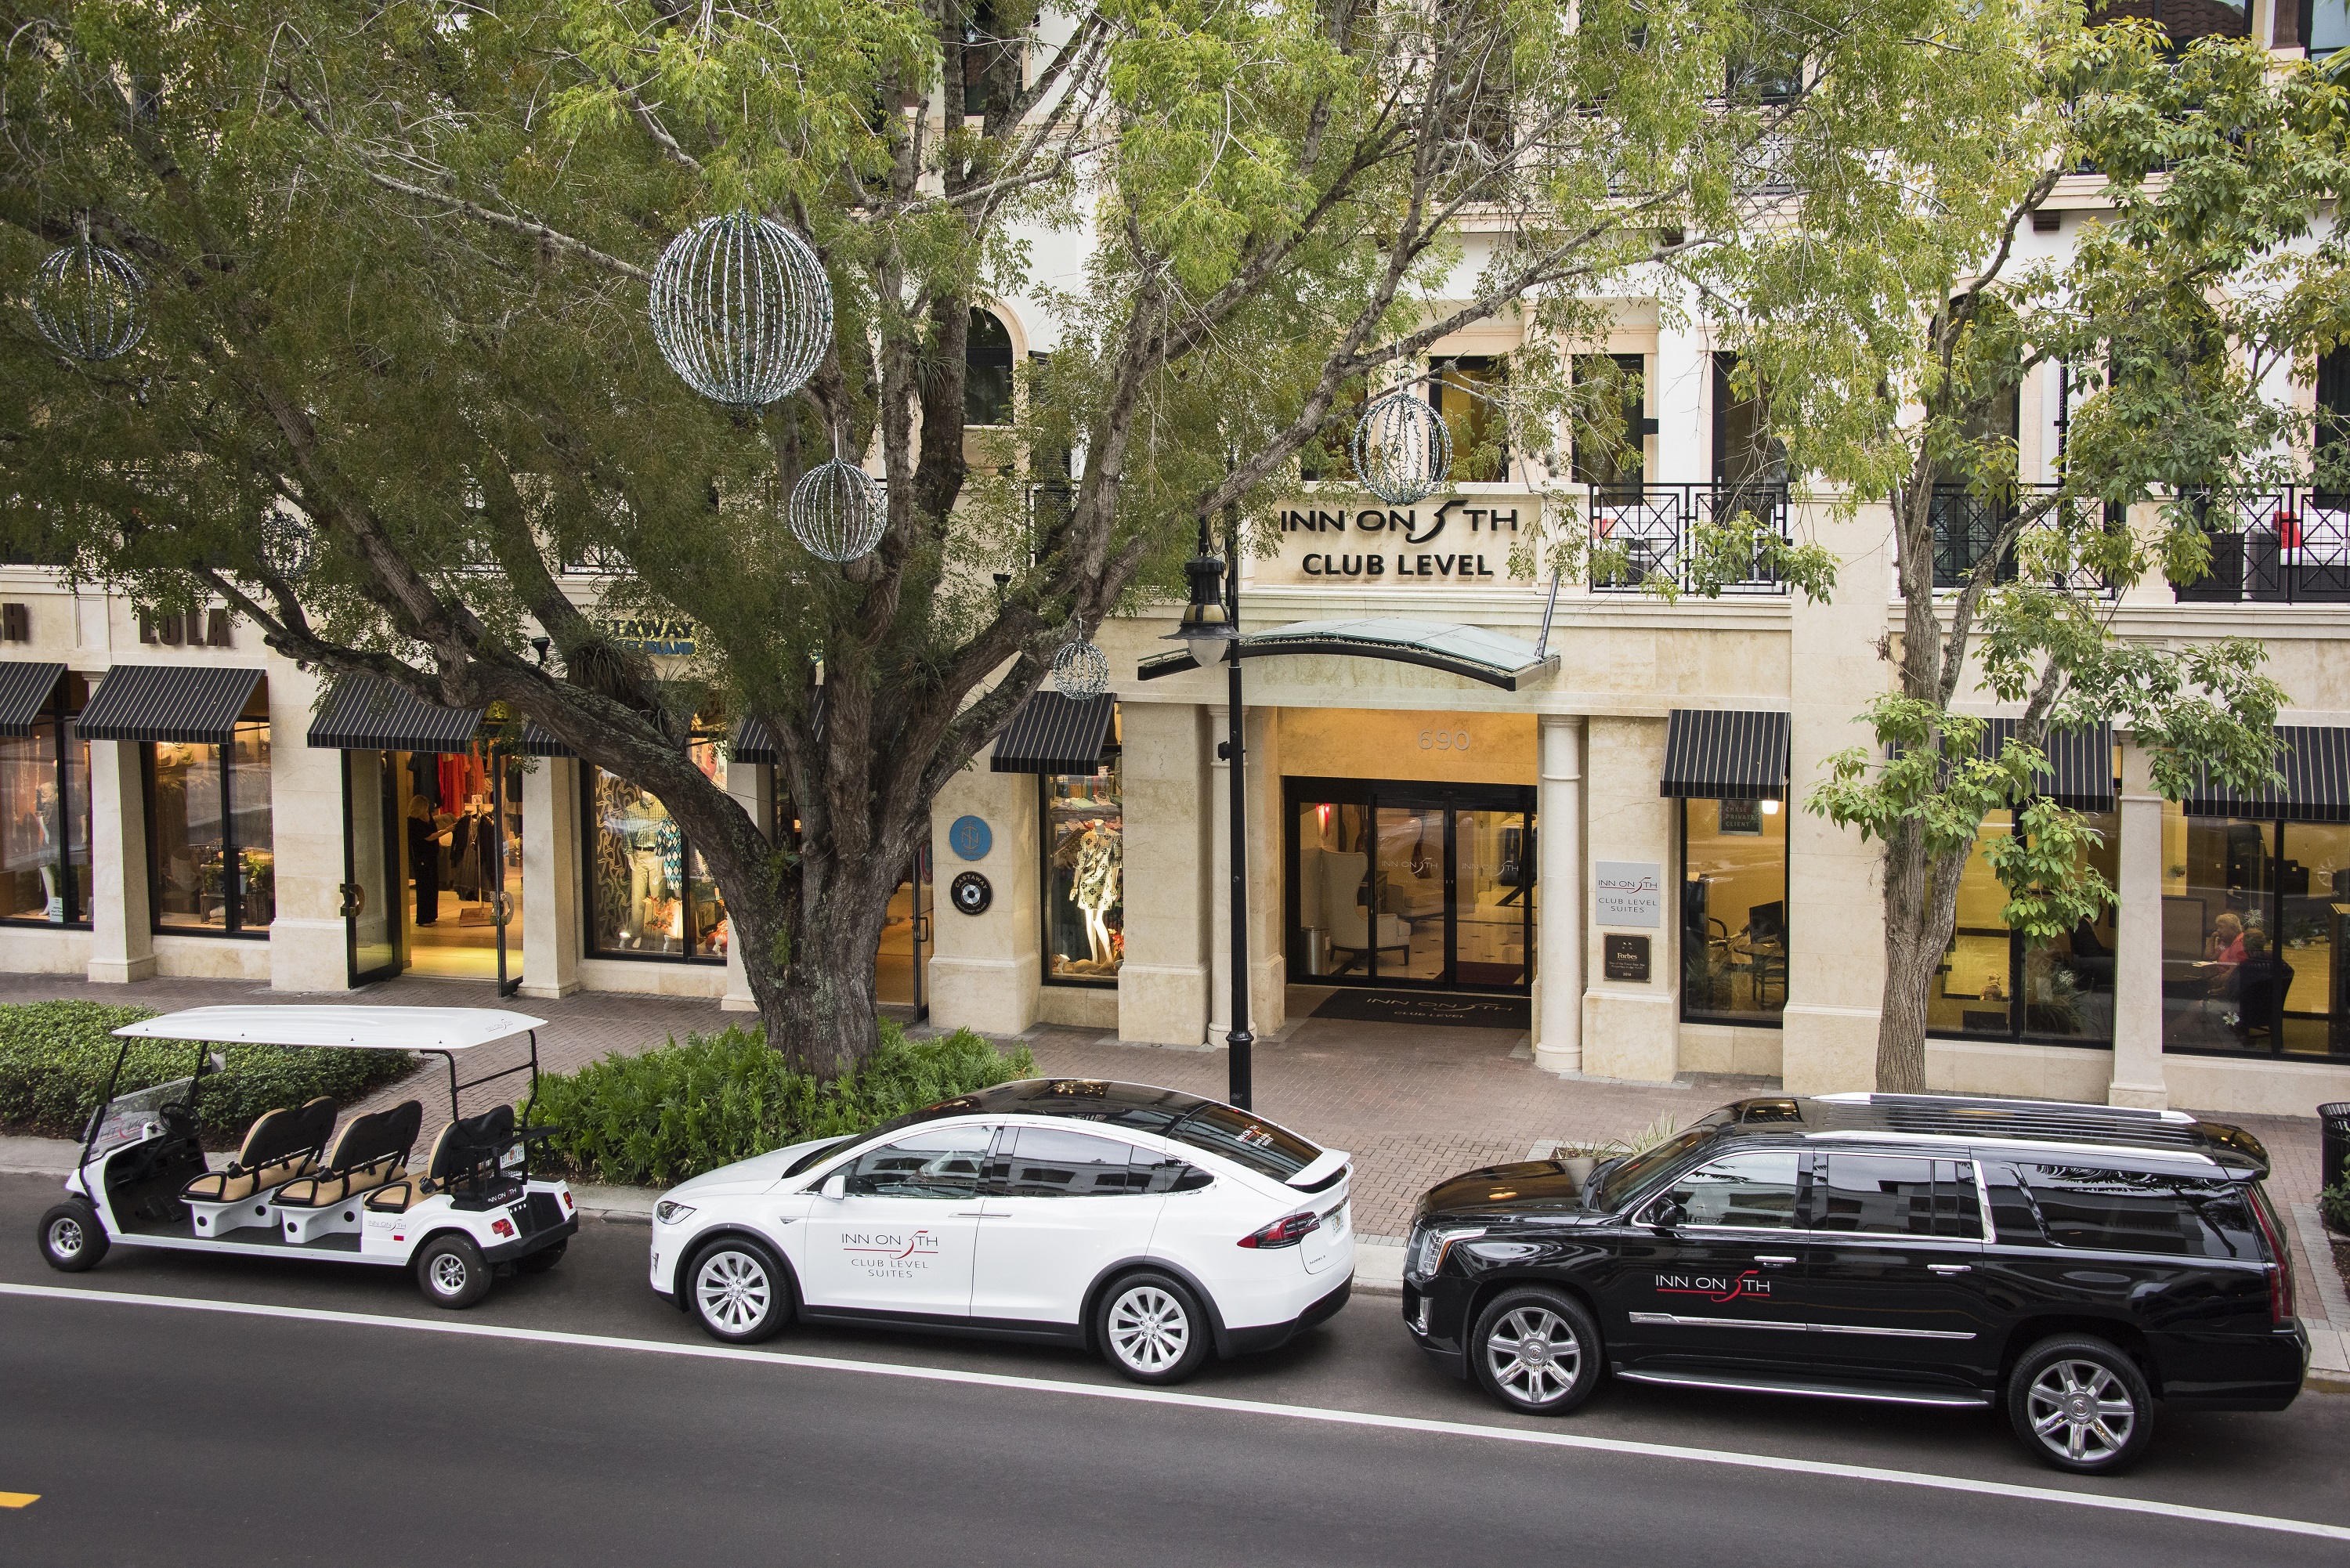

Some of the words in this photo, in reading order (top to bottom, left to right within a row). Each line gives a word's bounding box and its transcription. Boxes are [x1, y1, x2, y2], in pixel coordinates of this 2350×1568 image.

[1281, 510, 1345, 532] INN
[1356, 510, 1415, 532] ON
[1405, 500, 1518, 544] 5TH
[1302, 553, 1385, 576] CLUB
[1397, 554, 1493, 576] LEVEL
[1418, 729, 1470, 750] 690
[1408, 858, 1438, 874] 5TH
[1489, 860, 1519, 876] 5TH
[956, 874, 987, 889] CASTAWAY
[1626, 876, 1658, 894] 5TH
[841, 1234, 870, 1245] INN
[875, 1234, 901, 1245] ON
[890, 1230, 938, 1259] 5TH
[851, 1259, 884, 1267] CLUB
[891, 1260, 929, 1269] LEVEL
[868, 1269, 913, 1278] SUITES
[1655, 1274, 1688, 1288] INN
[1695, 1277, 1726, 1290] ON
[1711, 1270, 1770, 1302] 5TH
